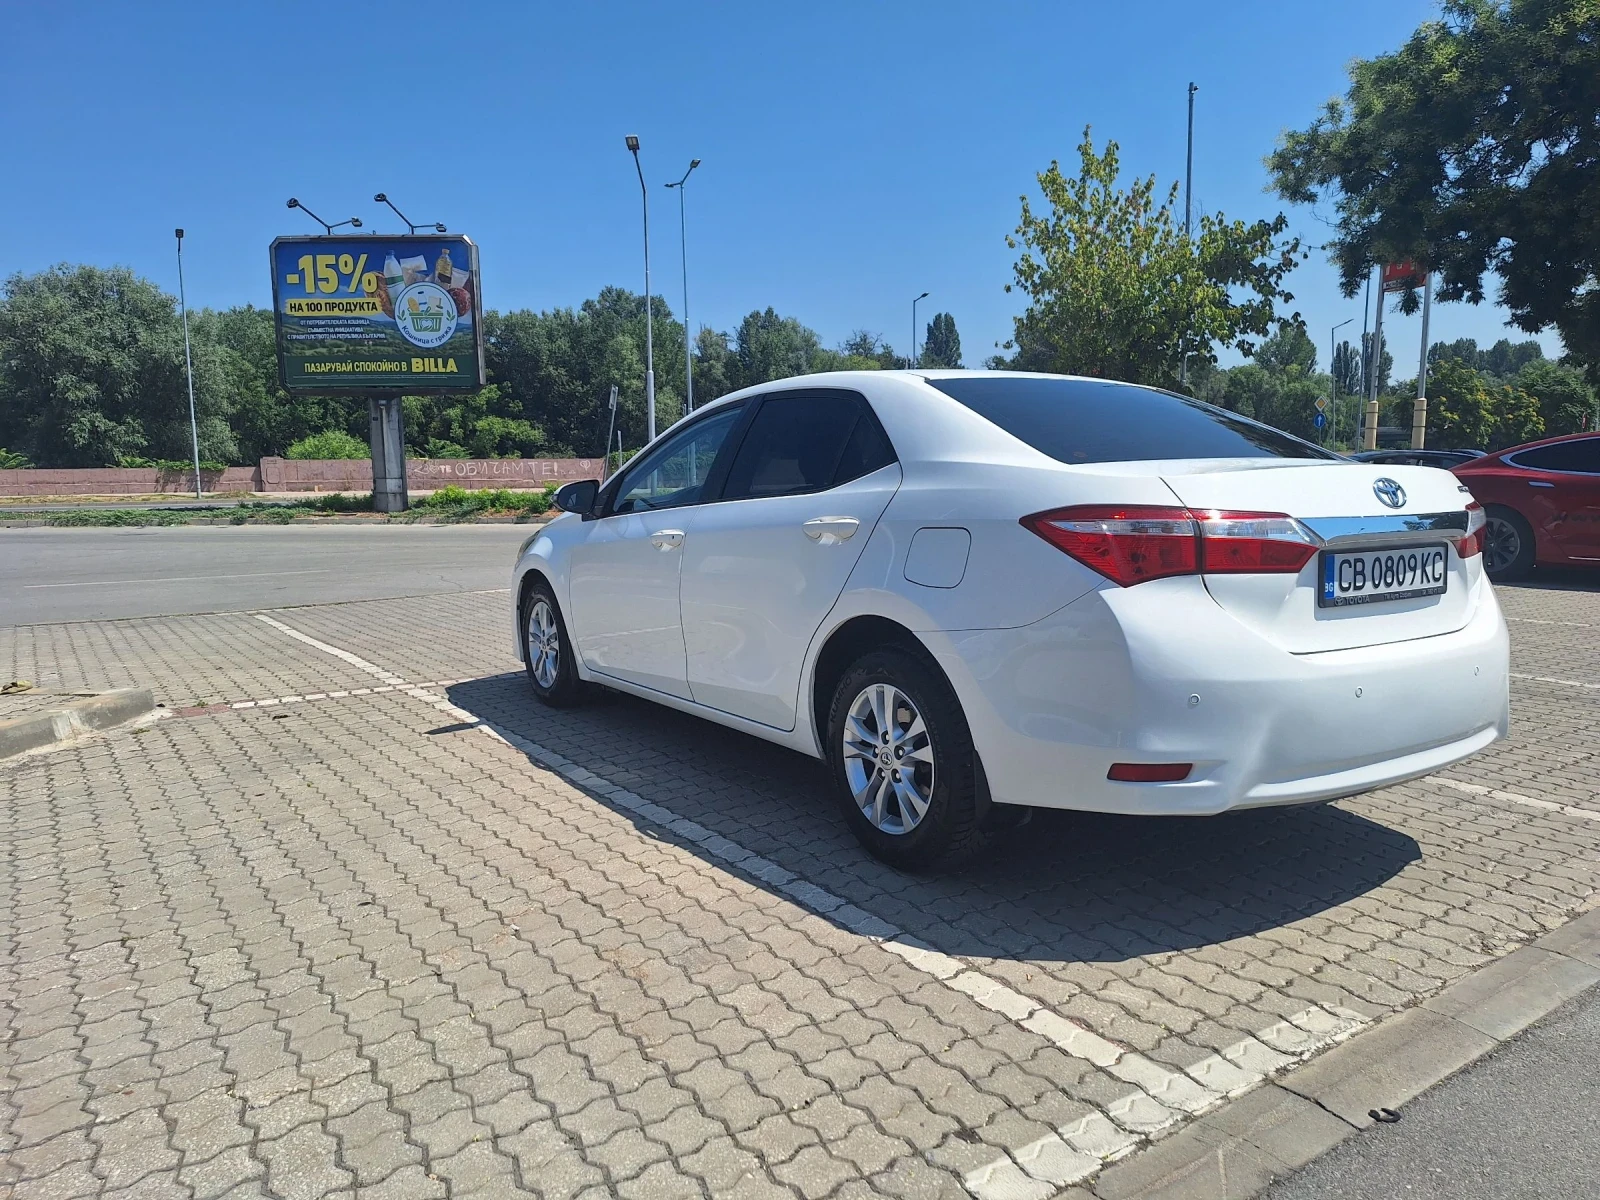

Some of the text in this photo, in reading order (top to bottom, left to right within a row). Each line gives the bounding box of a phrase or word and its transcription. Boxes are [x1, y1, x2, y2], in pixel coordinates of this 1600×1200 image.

[286, 253, 378, 294] -15%
[289, 301, 378, 313] НА 100 ПРОДУКТА
[401, 325, 430, 344] Кошница
[435, 326, 452, 342] грижа
[304, 357, 459, 373] ПАЗАРУВАЙ СПОКОЙНО В BILLA
[1338, 551, 1443, 593] CB 0809 KC
[1345, 595, 1370, 605] TOYOTA
